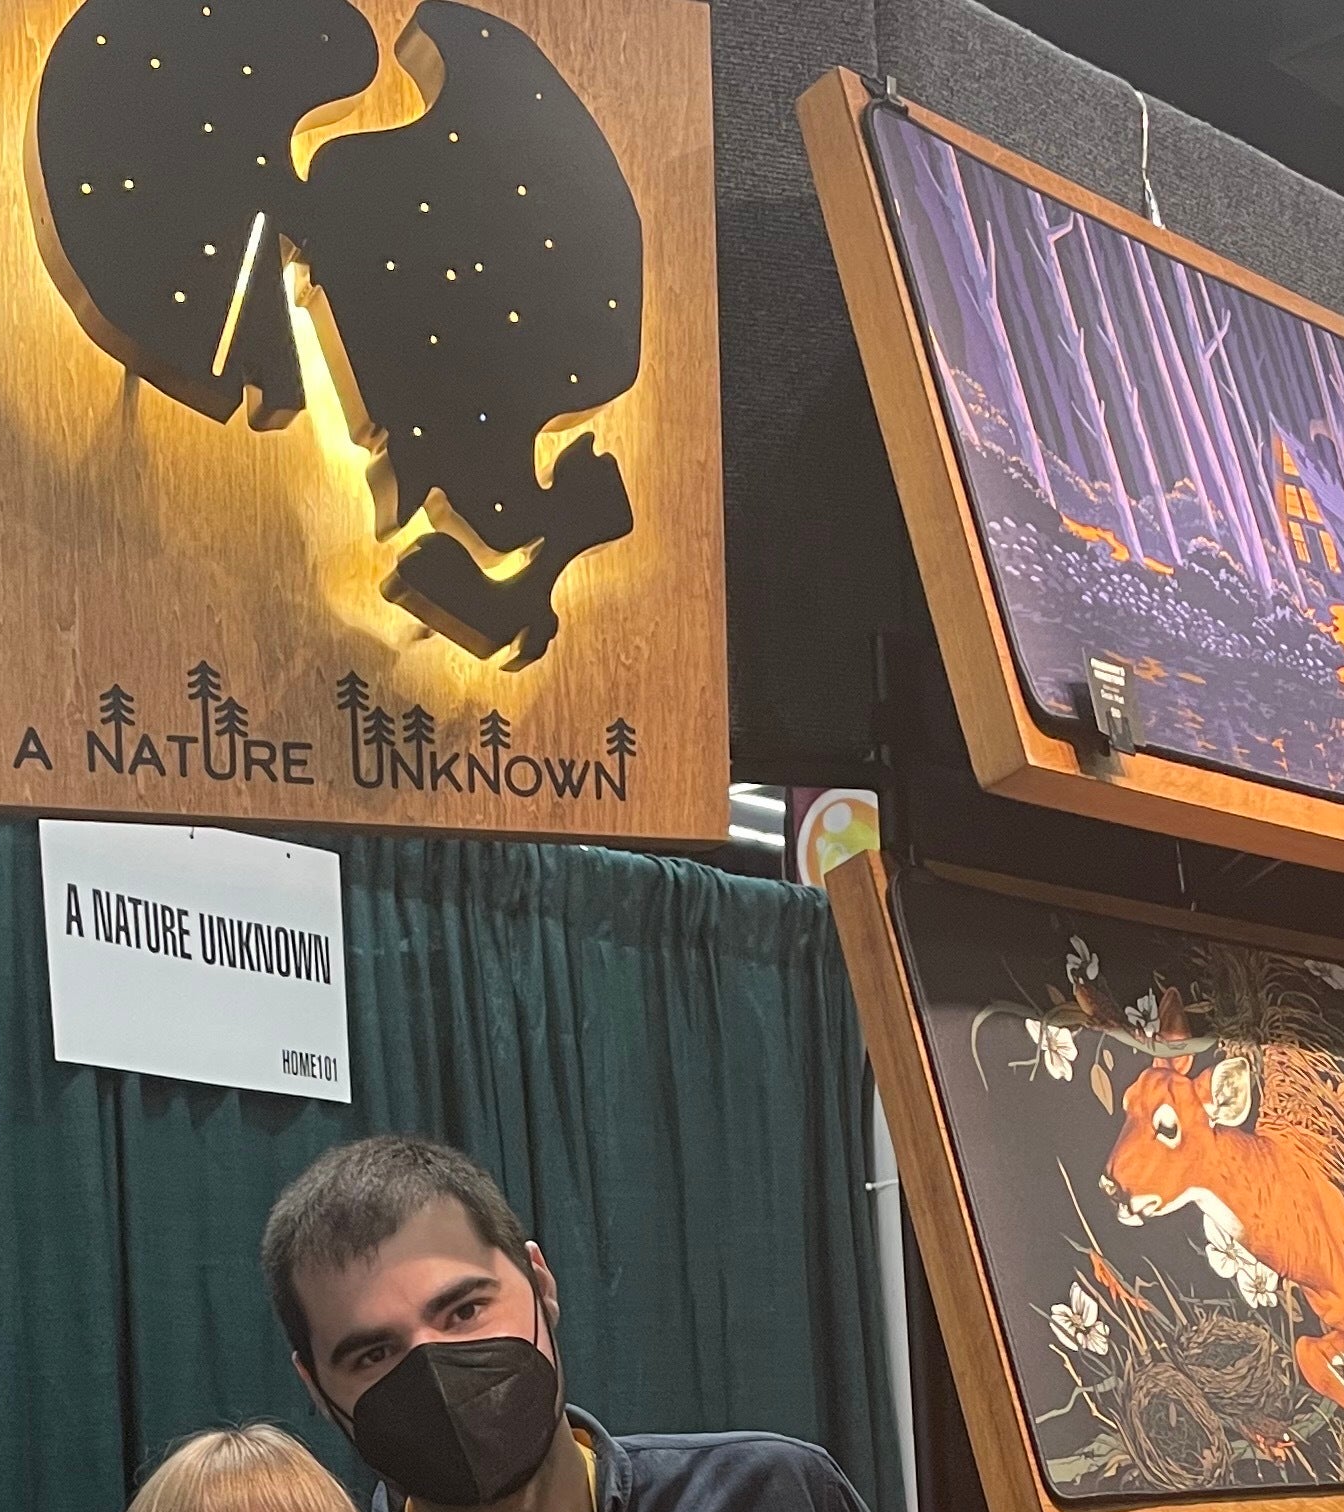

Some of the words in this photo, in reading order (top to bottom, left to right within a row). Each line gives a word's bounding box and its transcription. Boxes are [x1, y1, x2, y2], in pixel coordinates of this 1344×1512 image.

[13, 726, 53, 770] A
[87, 676, 314, 786] NATURE
[337, 690, 637, 801] UNKNOWN
[66, 883, 84, 938] A
[92, 888, 193, 960] NATURE
[199, 912, 331, 985] UNKNOWN
[282, 1049, 338, 1082] HOME101
